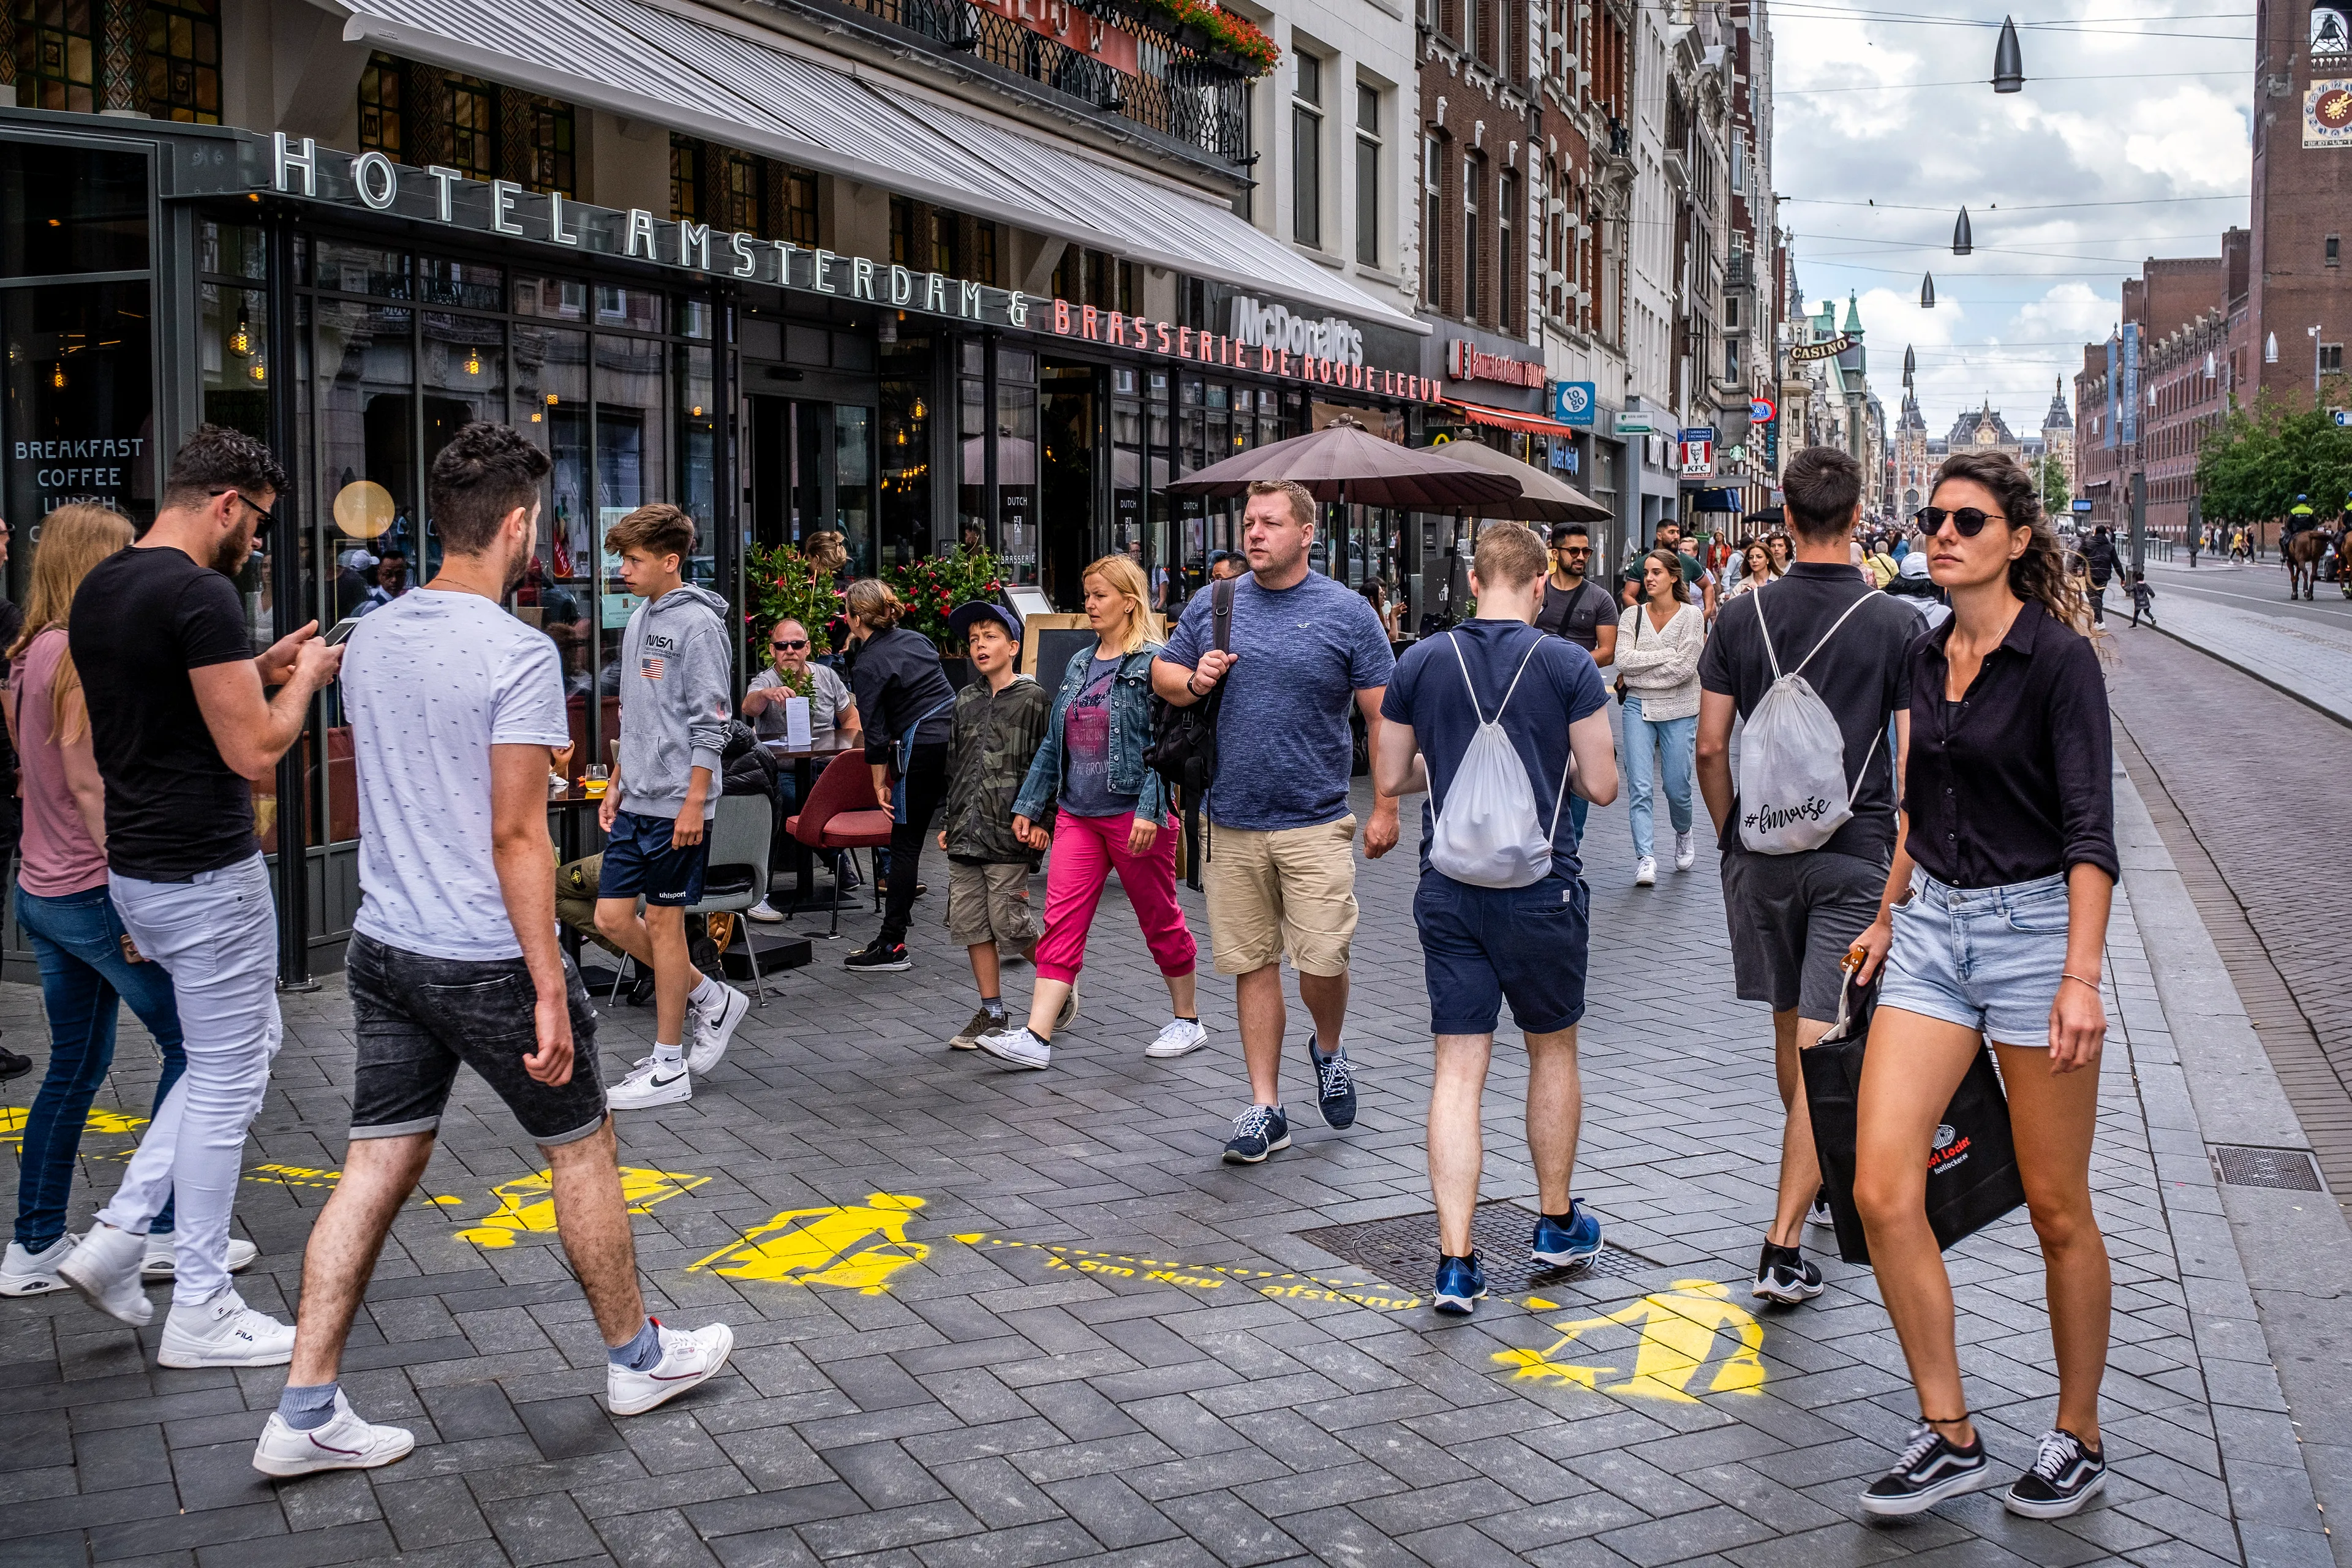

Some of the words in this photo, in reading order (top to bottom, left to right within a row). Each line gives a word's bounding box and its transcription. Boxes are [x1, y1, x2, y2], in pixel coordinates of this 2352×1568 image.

[271, 132, 577, 244] HOTEL
[624, 208, 981, 319] AMSTERDAM
[1007, 290, 1028, 327] &
[1053, 298, 1246, 368] BRASSERIE
[1262, 345, 1289, 375] DE
[1304, 353, 1374, 391] ROODE
[1385, 370, 1441, 402] LEEUW
[1230, 296, 1363, 366] McDonald's
[1791, 339, 1848, 360] CASINO
[1474, 352, 1523, 385] amsterdam
[1524, 362, 1547, 390] TODAY
[1567, 390, 1580, 401] to
[1571, 398, 1585, 411] go
[15, 439, 143, 459] BREAKFAST
[38, 468, 121, 487] COFFEE
[1008, 497, 1027, 506] DUTCH
[1120, 500, 1136, 508] DUTCH
[1183, 502, 1198, 510] DUTCH
[1001, 554, 1035, 565] BRASSERIE
[646, 635, 673, 650] NASA
[1072, 761, 1085, 775] THE
[1086, 760, 1109, 776] GROU
[659, 891, 686, 899] uhlsport
[1927, 1153, 1941, 1168] oot
[1142, 1270, 1226, 1289] Hou
[1260, 1284, 1422, 1310] afstand
[235, 1330, 252, 1341] FILA
